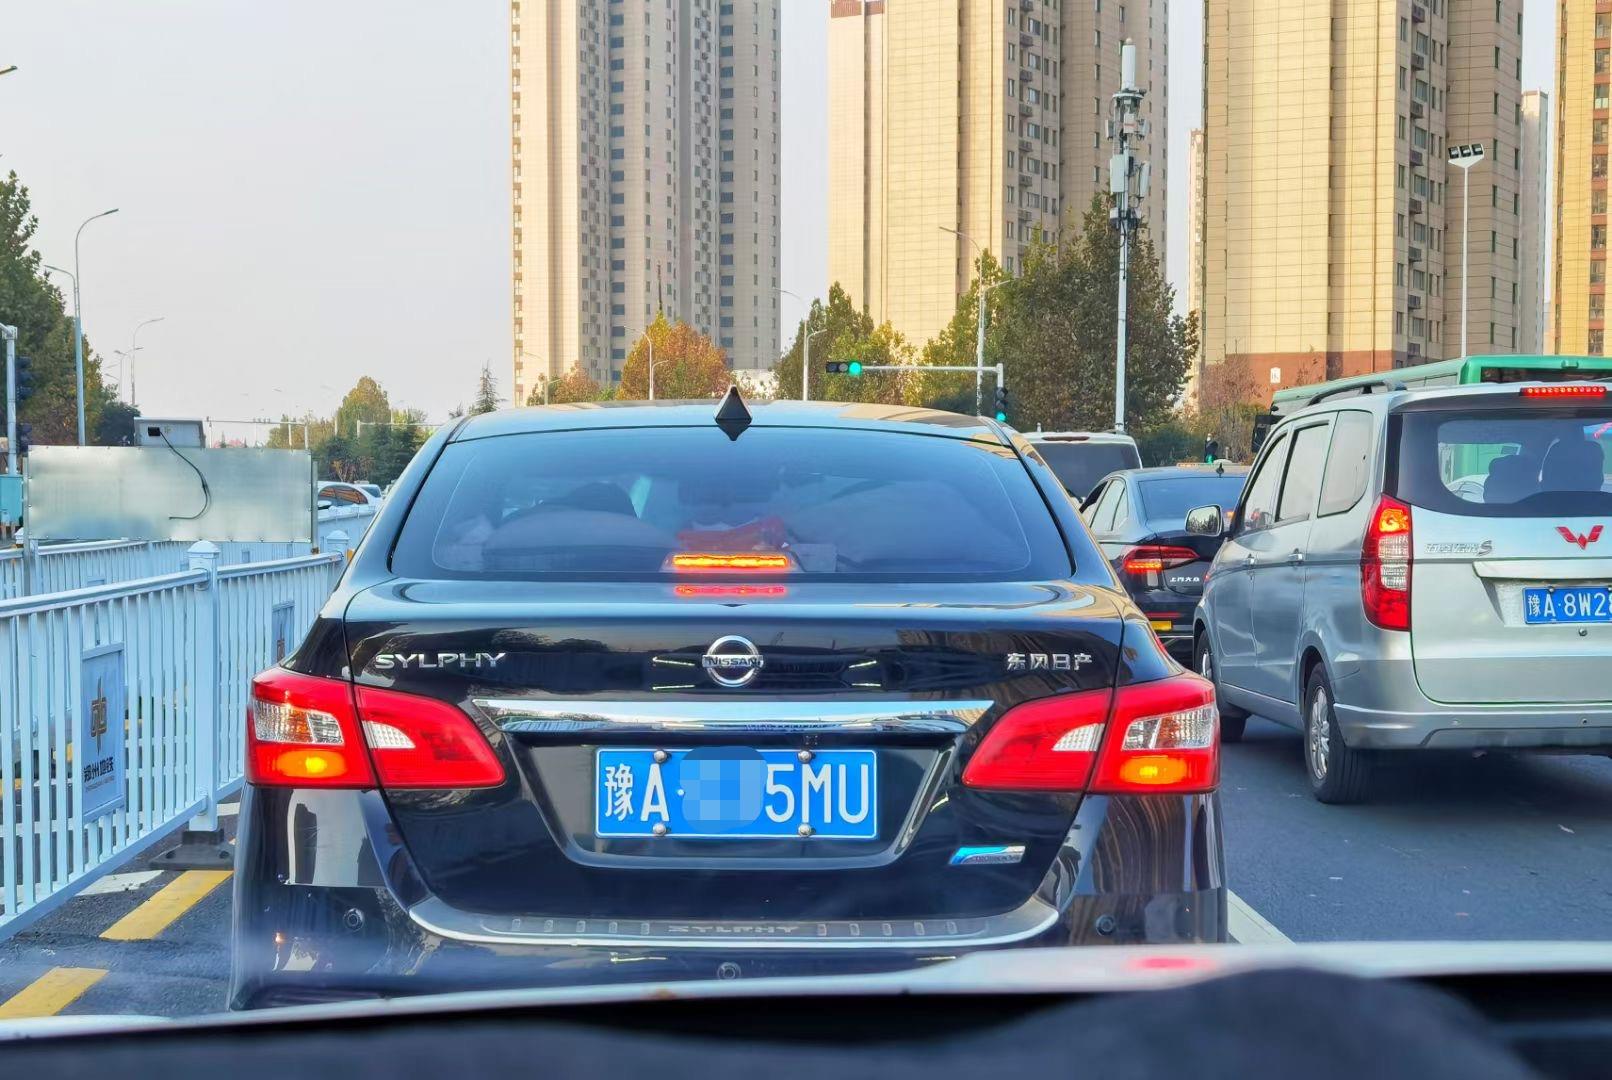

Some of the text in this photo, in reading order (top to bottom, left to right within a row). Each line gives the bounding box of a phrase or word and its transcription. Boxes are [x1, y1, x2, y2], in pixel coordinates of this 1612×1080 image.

[374, 652, 506, 669] SYLPHY
[708, 656, 758, 668] NISSAN
[1006, 652, 1093, 671] 东风日产
[604, 763, 870, 823] 豫A·5MU
